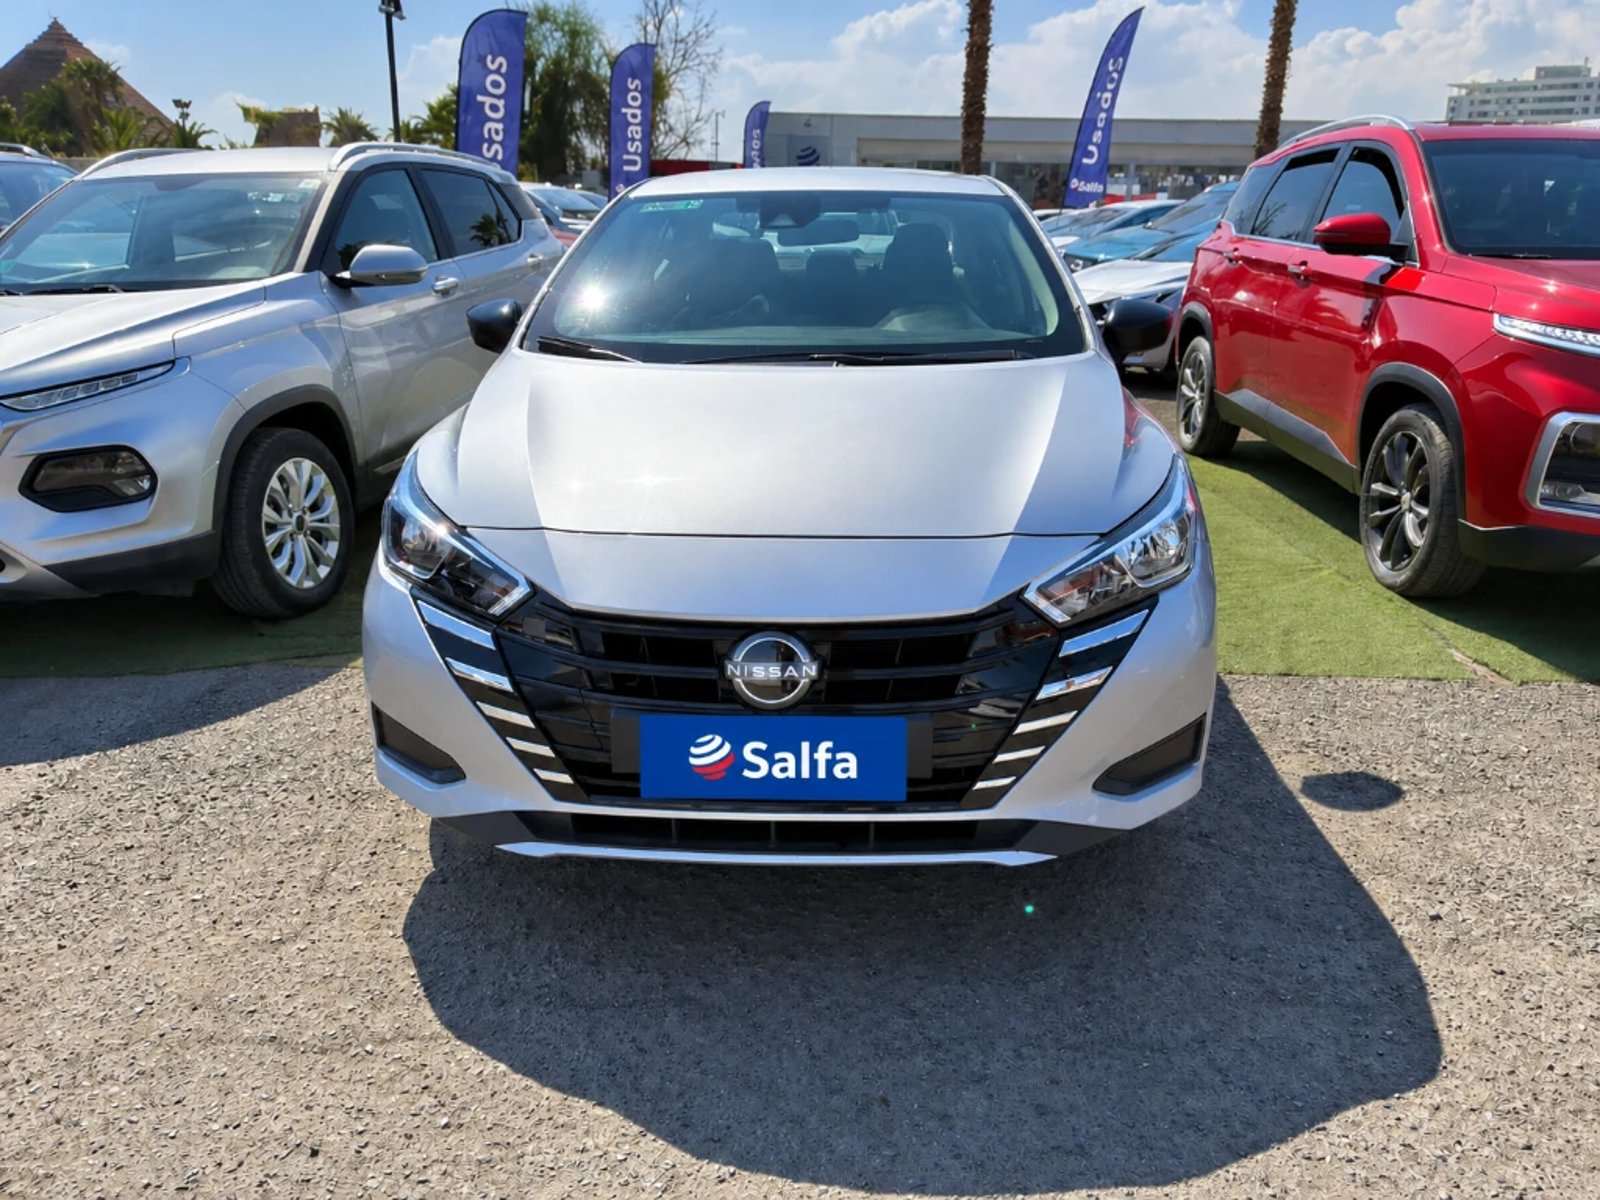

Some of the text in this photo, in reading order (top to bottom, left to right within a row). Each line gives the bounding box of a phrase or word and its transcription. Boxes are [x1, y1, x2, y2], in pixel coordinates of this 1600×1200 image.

[476, 54, 508, 161] sados
[621, 77, 642, 171] Usados
[1081, 56, 1123, 165] Usados
[727, 663, 818, 678] NISSAN
[742, 740, 858, 780] Salfa
